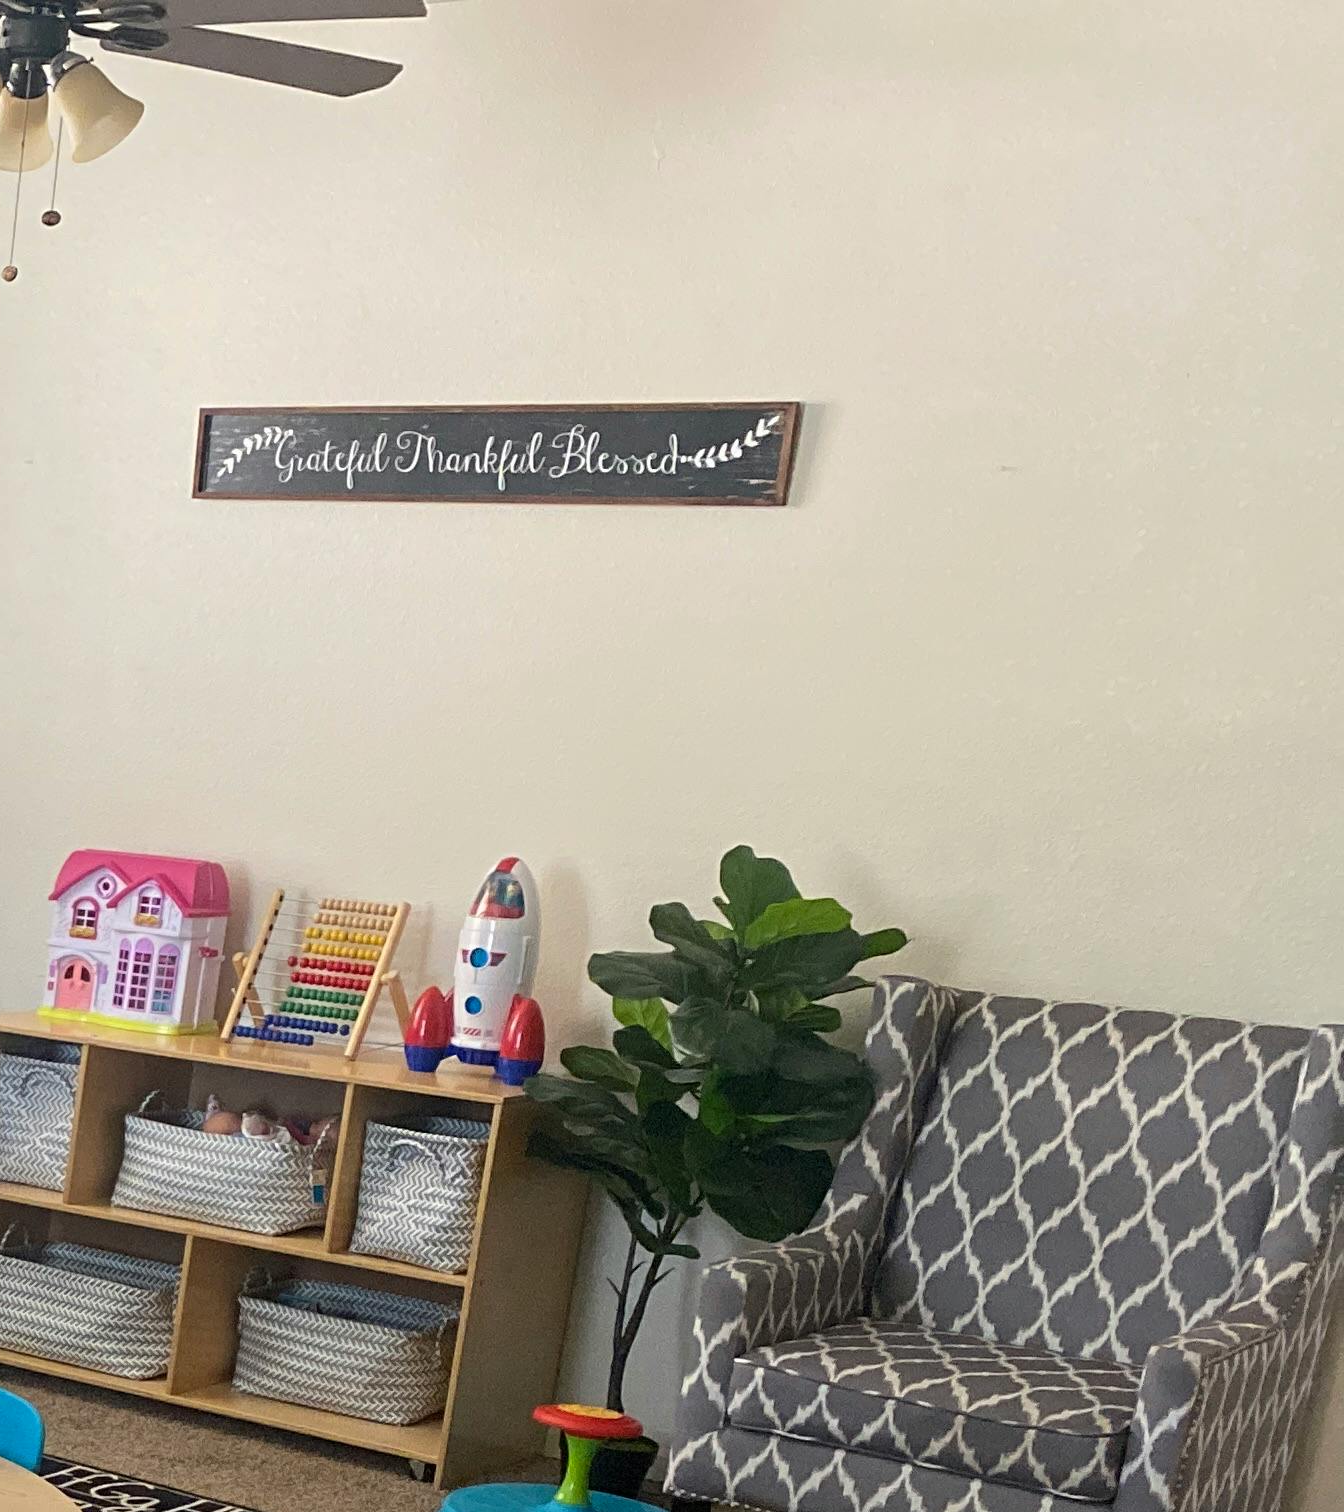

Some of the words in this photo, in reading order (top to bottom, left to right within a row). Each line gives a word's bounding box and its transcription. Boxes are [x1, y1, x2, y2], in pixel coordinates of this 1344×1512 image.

[274, 432, 390, 490] Grateful
[395, 432, 547, 491] Thankful
[548, 424, 681, 480] Blessed
